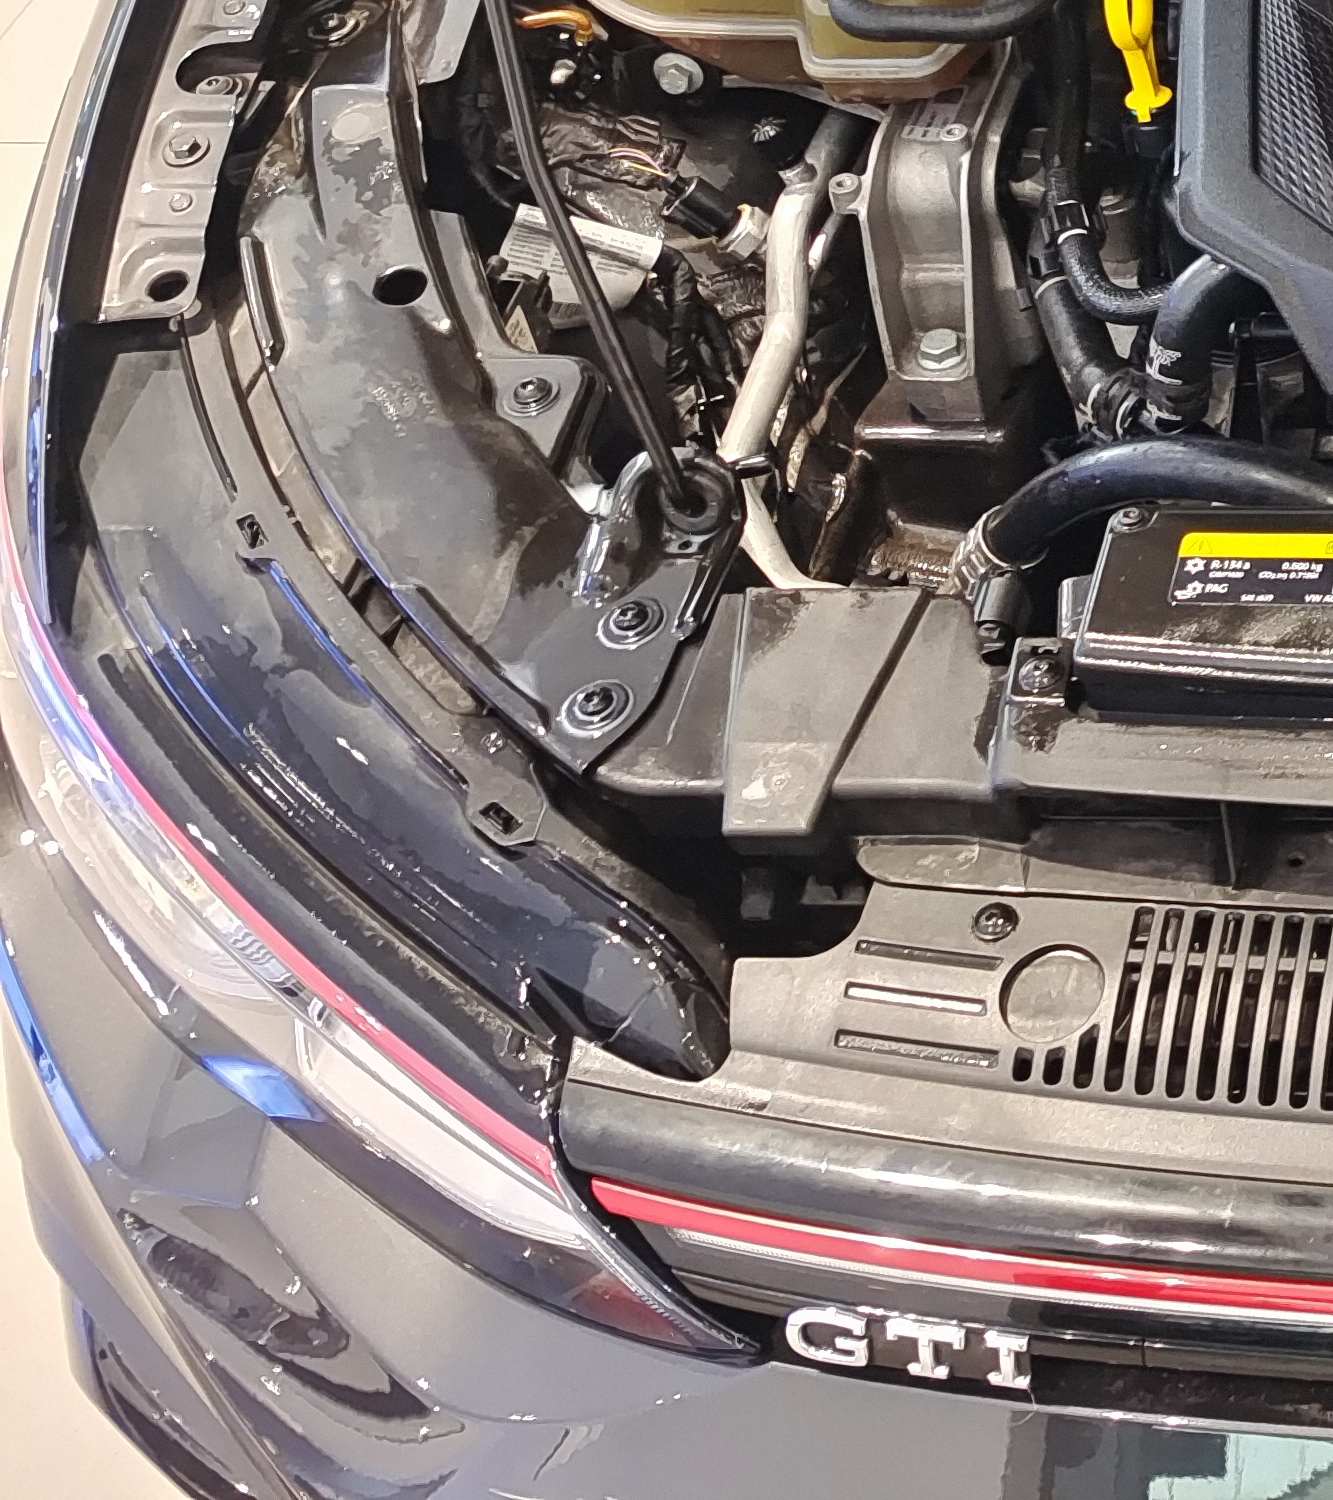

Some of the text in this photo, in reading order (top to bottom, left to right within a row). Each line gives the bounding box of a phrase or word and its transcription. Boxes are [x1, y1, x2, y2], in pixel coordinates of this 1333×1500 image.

[1311, 562, 1324, 572] kg
[1204, 583, 1229, 593] PAG
[1304, 594, 1323, 603] VW
[784, 1305, 1032, 1391] GTI
